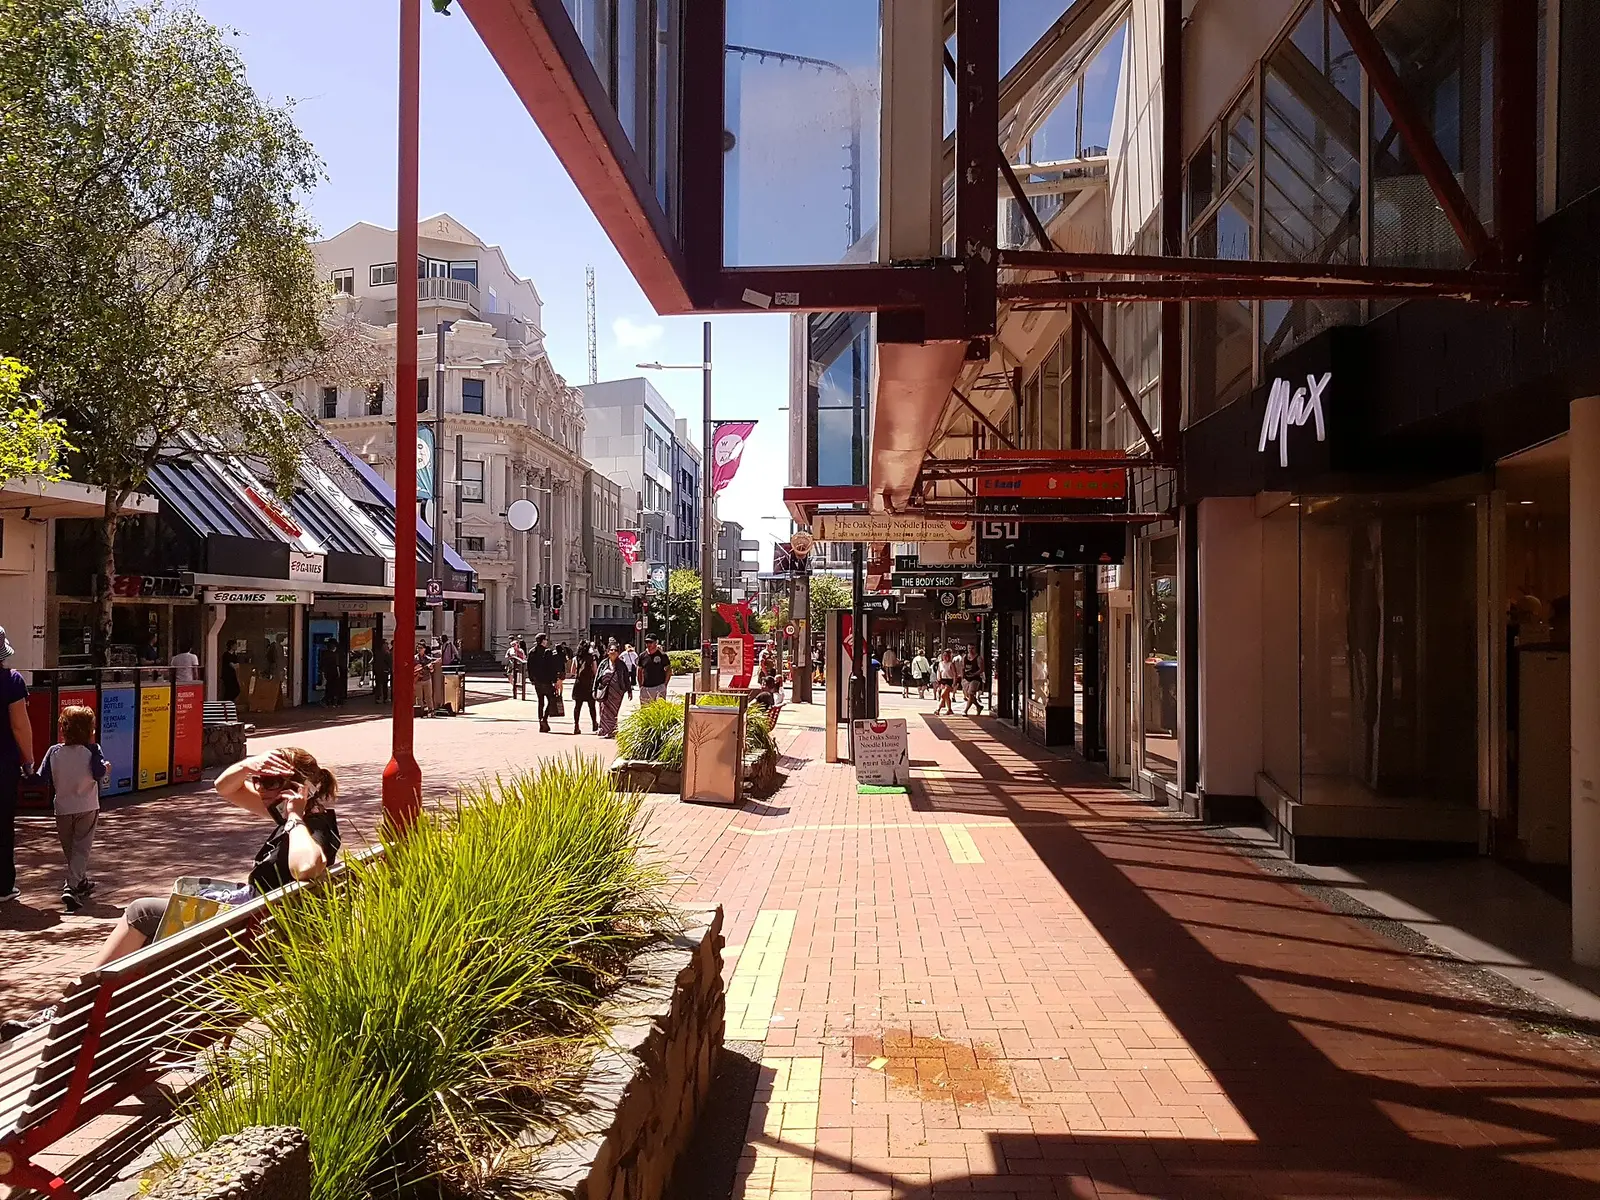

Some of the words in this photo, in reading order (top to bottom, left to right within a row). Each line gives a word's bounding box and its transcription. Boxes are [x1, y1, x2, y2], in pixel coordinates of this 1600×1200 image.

[838, 521, 851, 529] The
[852, 521, 870, 529] Oaks
[872, 521, 891, 530] Satay
[894, 520, 920, 529] Noodle
[921, 521, 944, 529] House
[300, 563, 322, 574] GAMES
[901, 578, 914, 586] THE
[915, 577, 935, 586] BODY
